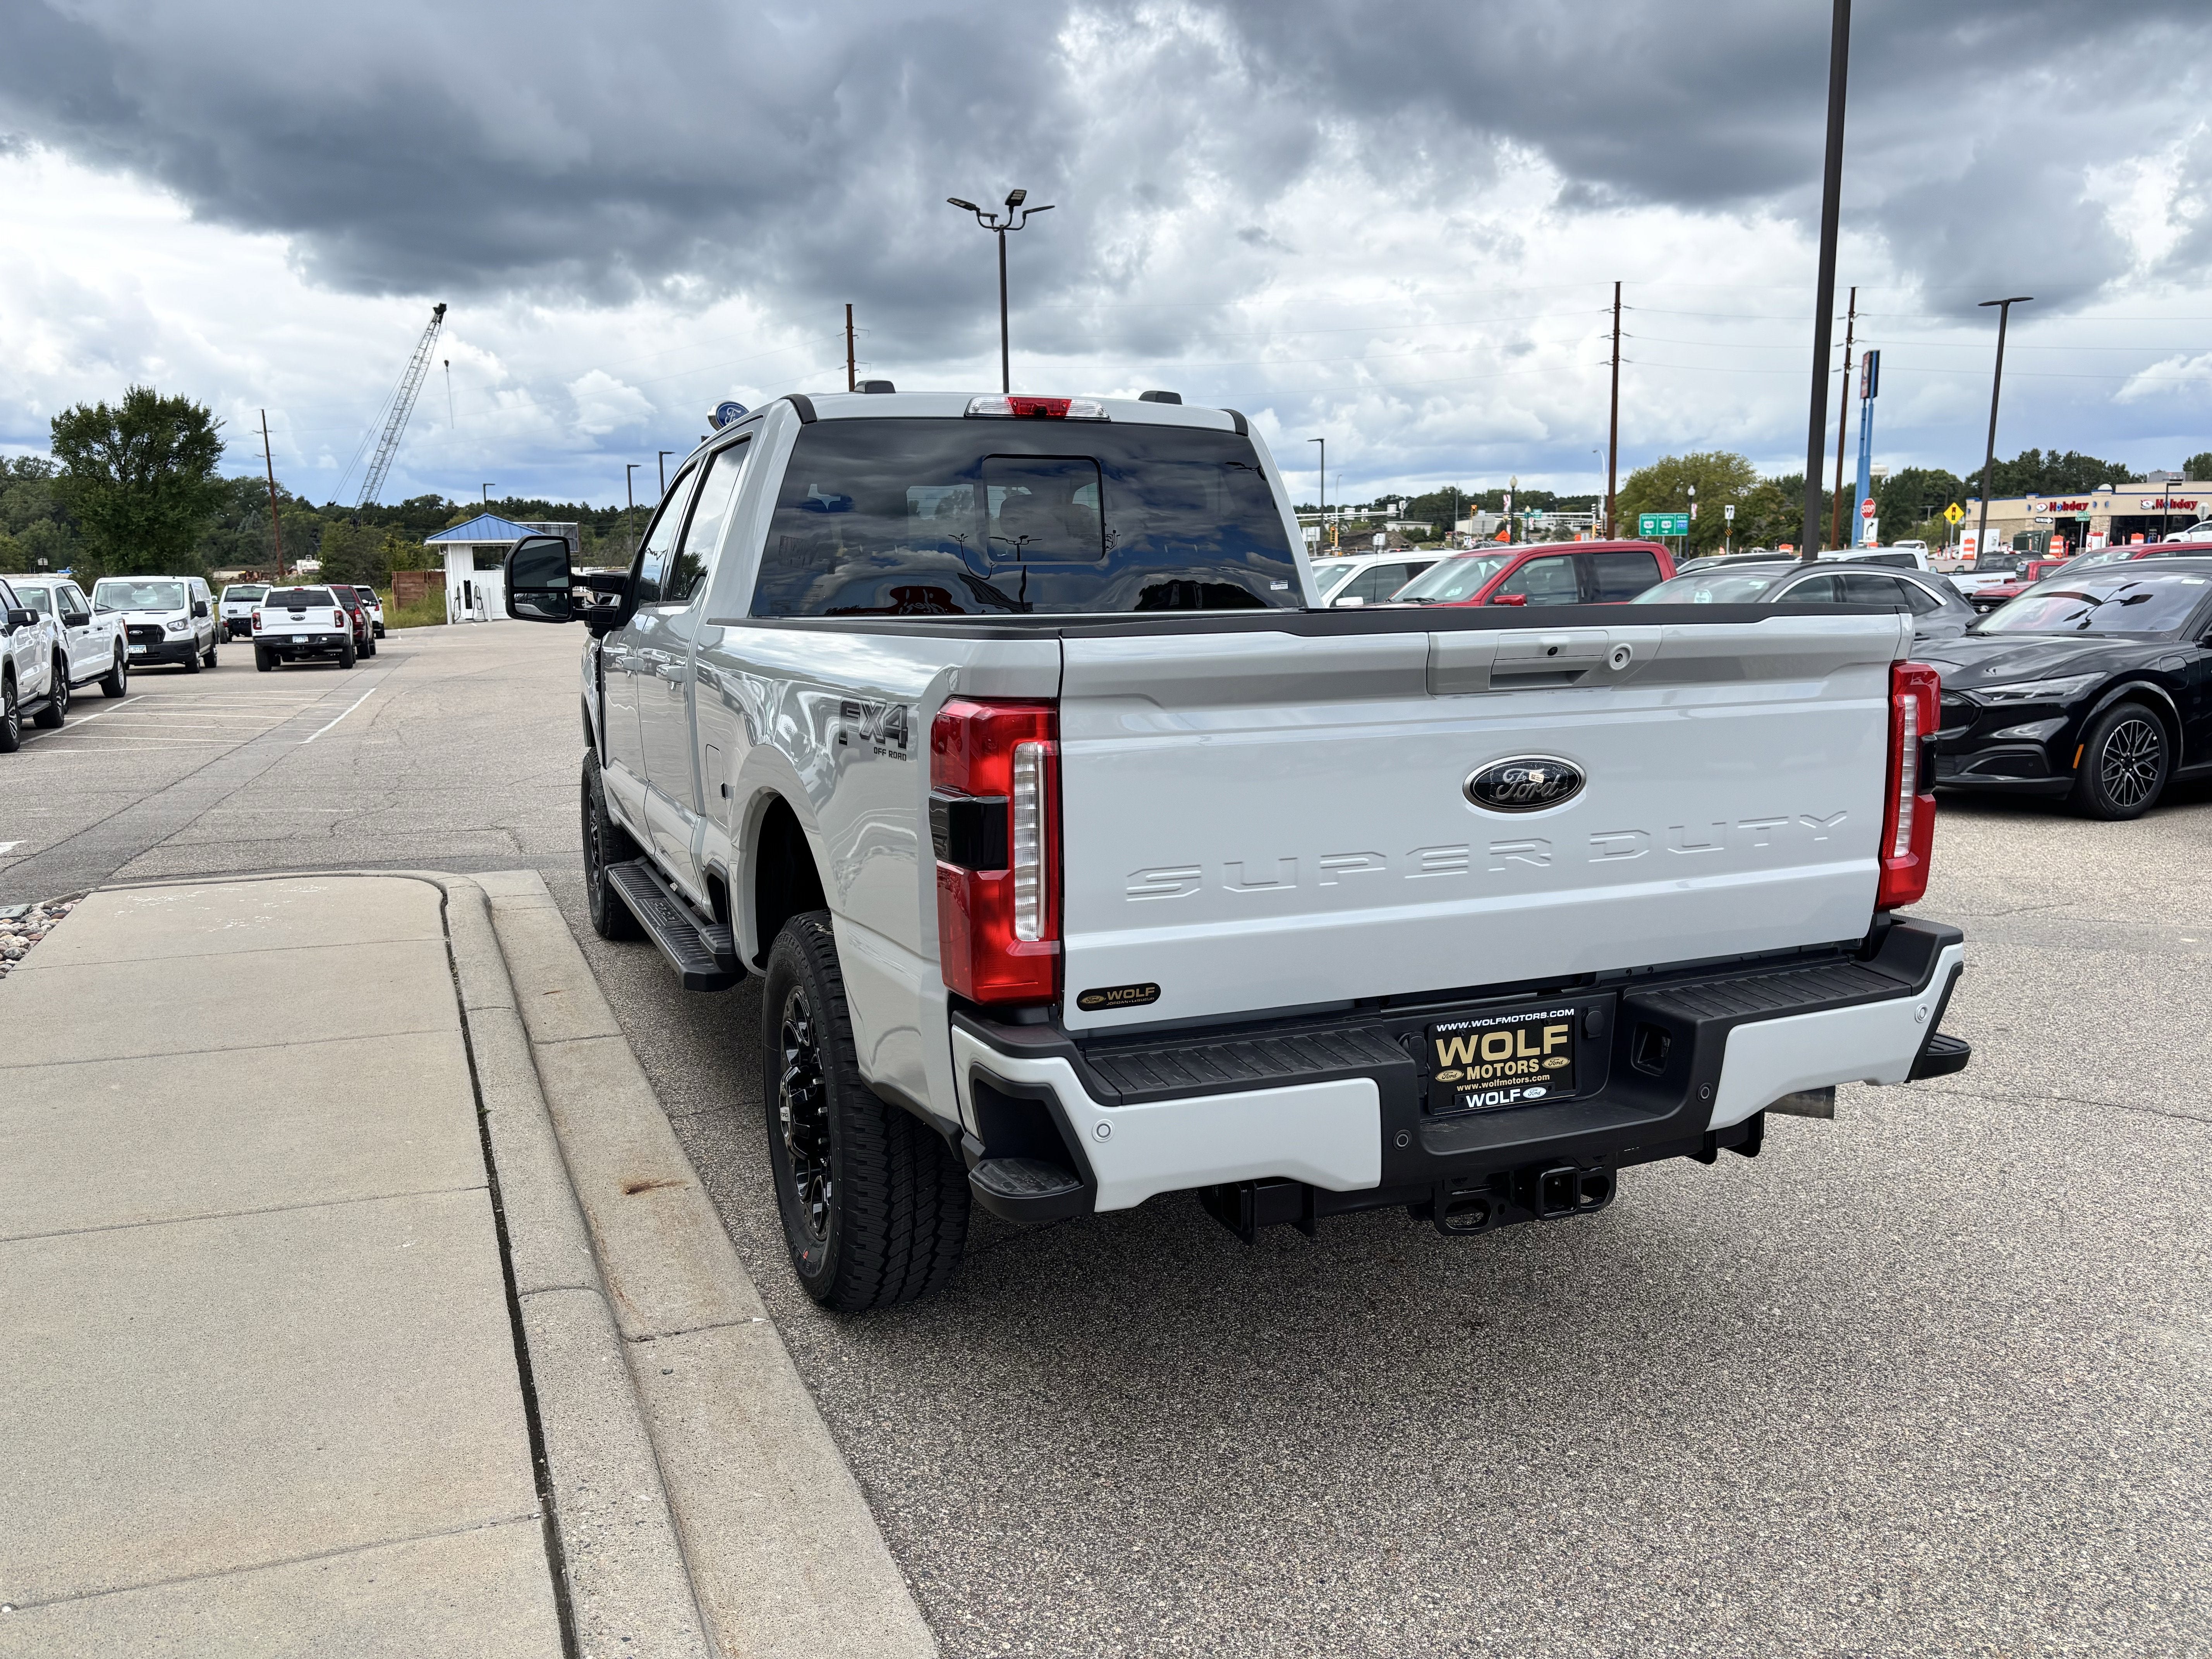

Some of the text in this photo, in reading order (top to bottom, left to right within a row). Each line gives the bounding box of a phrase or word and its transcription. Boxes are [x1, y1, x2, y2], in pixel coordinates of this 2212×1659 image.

[1862, 505, 1875, 513] STOP
[839, 698, 908, 750] FX4
[874, 747, 907, 761] OFF ROAD
[1496, 768, 1559, 800] Ford
[1125, 811, 1847, 902] SUPER DUTY
[1107, 987, 1155, 1000] WOLF
[1437, 1008, 1574, 1032] WWW.WOLFMOTORS.COM
[1436, 1024, 1568, 1067] WOLF
[1467, 1059, 1539, 1080] MOTORS
[1457, 1074, 1550, 1091] www.wolfmotors.com
[1466, 1089, 1520, 1108] WOLF
